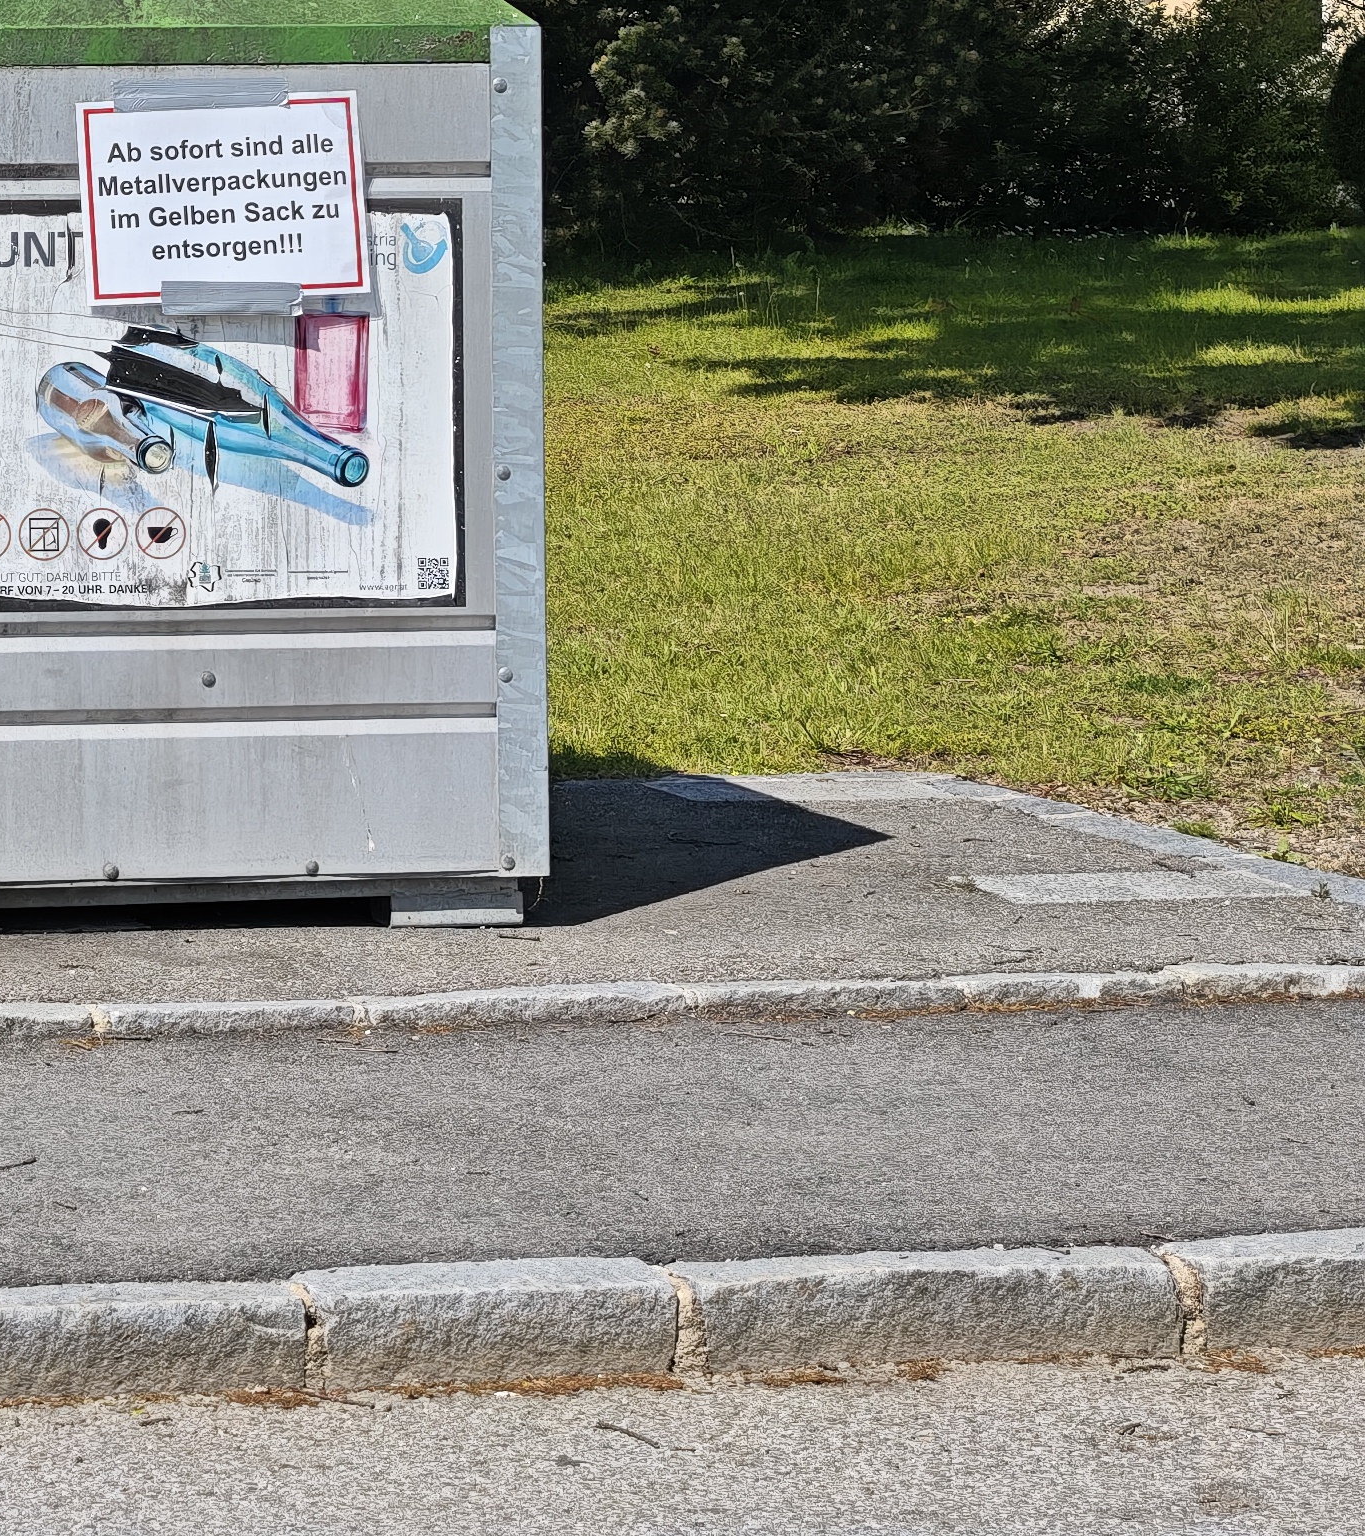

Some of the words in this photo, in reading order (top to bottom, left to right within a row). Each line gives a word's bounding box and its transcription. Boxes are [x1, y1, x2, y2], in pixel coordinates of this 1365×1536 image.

[108, 143, 141, 163] Ab
[151, 139, 223, 160] sofort
[231, 135, 282, 157] sind
[292, 134, 333, 154] alle
[99, 169, 346, 196] Metallverpackungen
[111, 210, 139, 228] im
[149, 206, 235, 226] Gelben
[245, 201, 304, 222] Sack
[312, 204, 339, 219] zu
[153, 233, 302, 261] entsorgen!!!
[46, 571, 88, 582] DARUM
[92, 571, 122, 582] BITTE
[17, 585, 43, 596] VON
